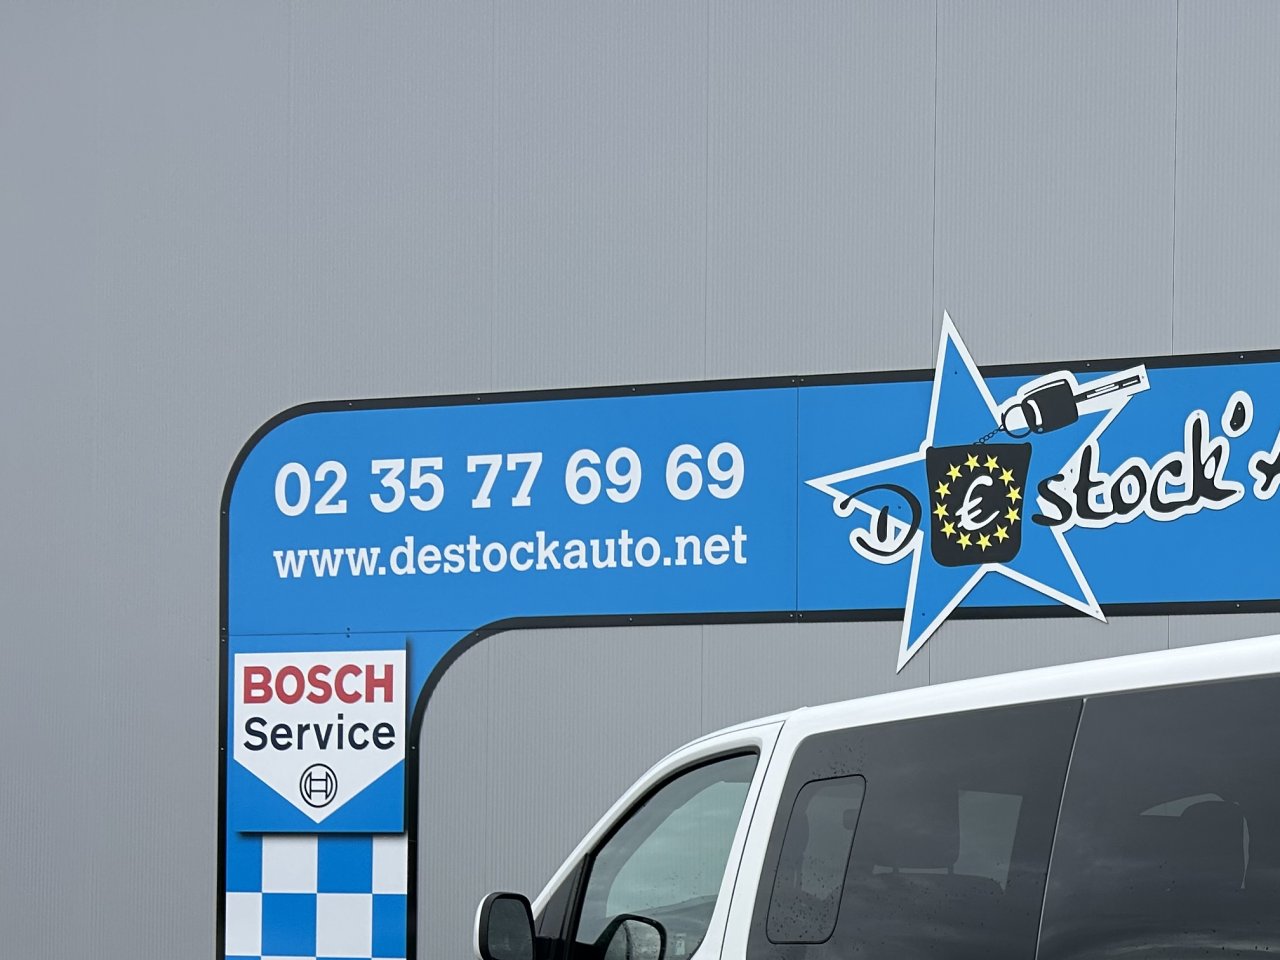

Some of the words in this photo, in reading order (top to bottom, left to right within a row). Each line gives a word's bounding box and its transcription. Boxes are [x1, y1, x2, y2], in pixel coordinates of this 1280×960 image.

[274, 460, 347, 517] 02
[370, 456, 445, 513] 35
[467, 451, 543, 509] 77
[565, 447, 642, 505] 69
[665, 442, 745, 501] 69
[272, 525, 747, 578] www.destockauto.net
[243, 663, 394, 705] BOSCH
[243, 713, 396, 752] Service
